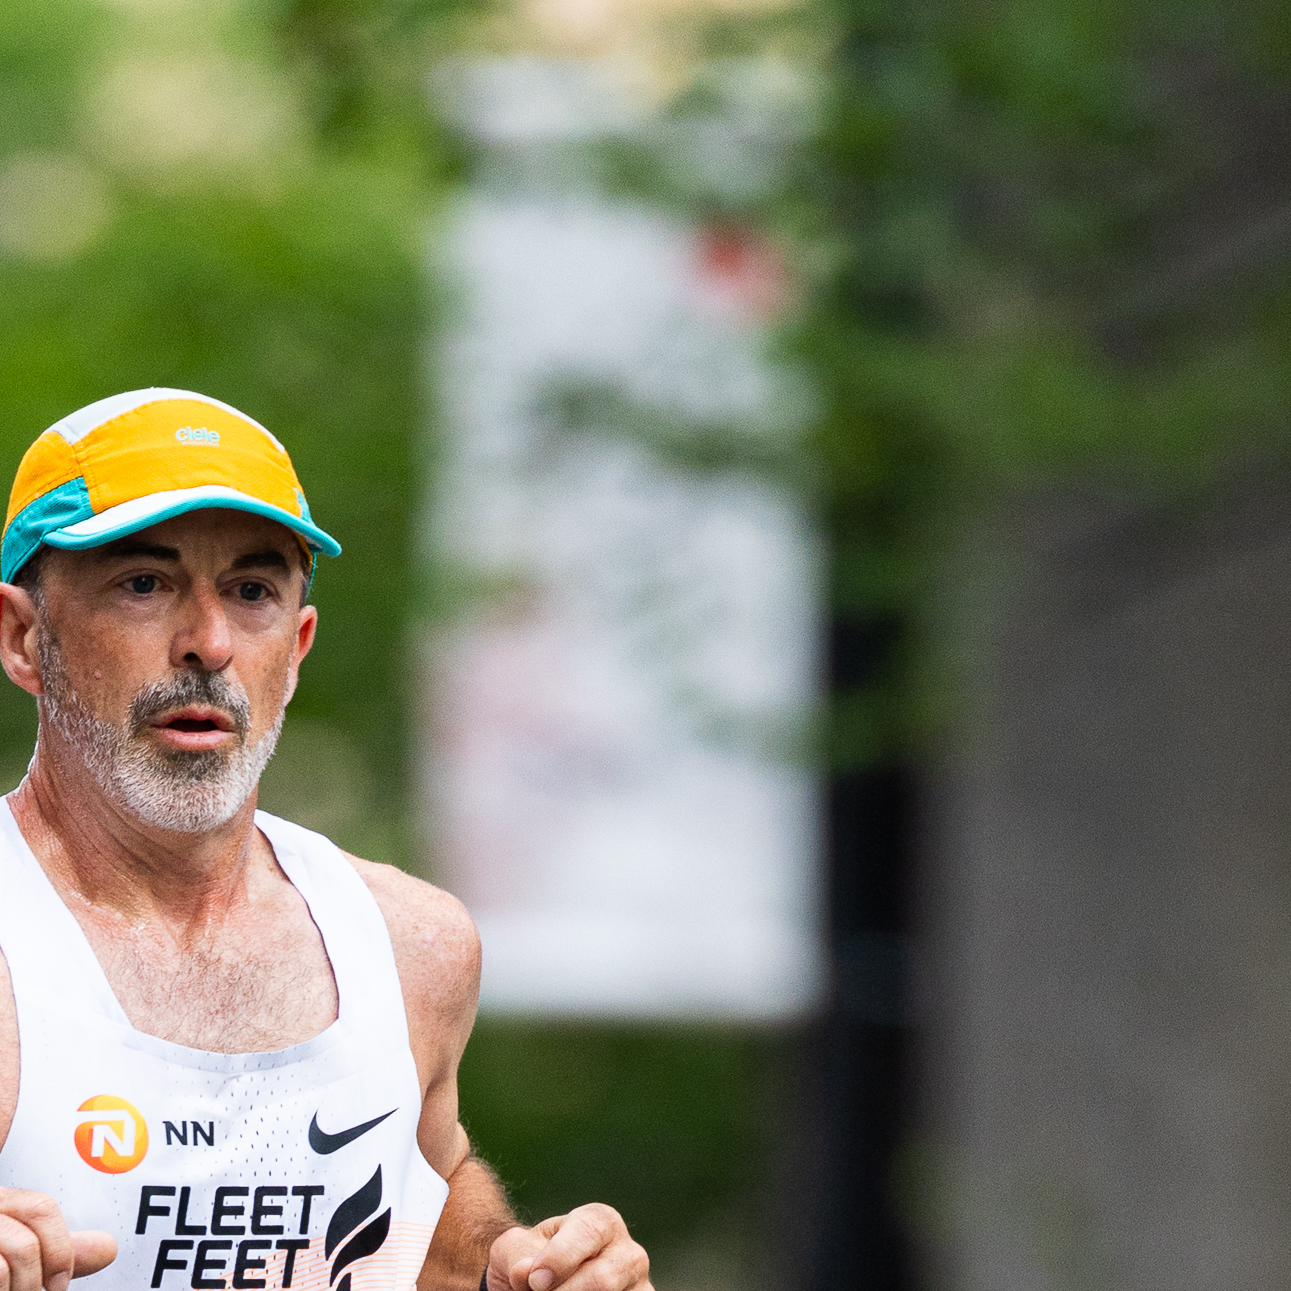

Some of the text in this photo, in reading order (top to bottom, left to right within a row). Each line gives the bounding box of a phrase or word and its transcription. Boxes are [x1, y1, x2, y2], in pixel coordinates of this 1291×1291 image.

[162, 1120, 215, 1147] NN
[135, 1185, 325, 1236] FLEET
[150, 1239, 310, 1290] FEET
